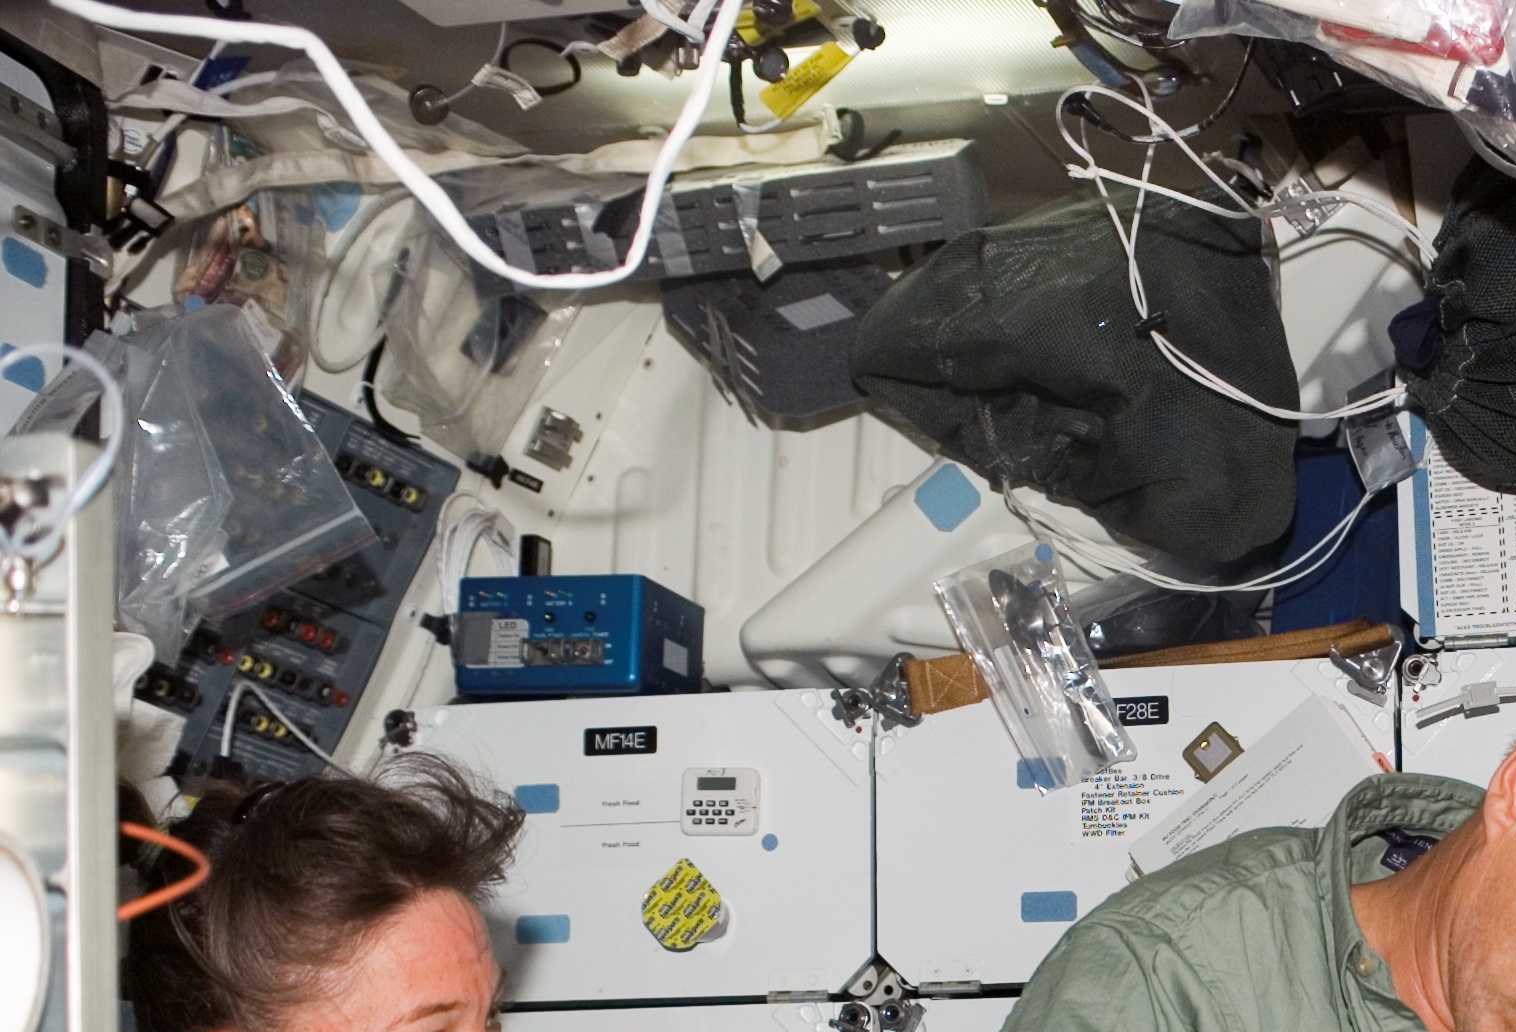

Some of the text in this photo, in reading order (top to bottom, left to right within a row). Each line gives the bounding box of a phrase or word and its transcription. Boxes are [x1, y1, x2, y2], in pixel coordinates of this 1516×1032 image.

[498, 621, 517, 629] LED
[1116, 702, 1160, 720] F28E
[595, 732, 646, 750] MF14E
